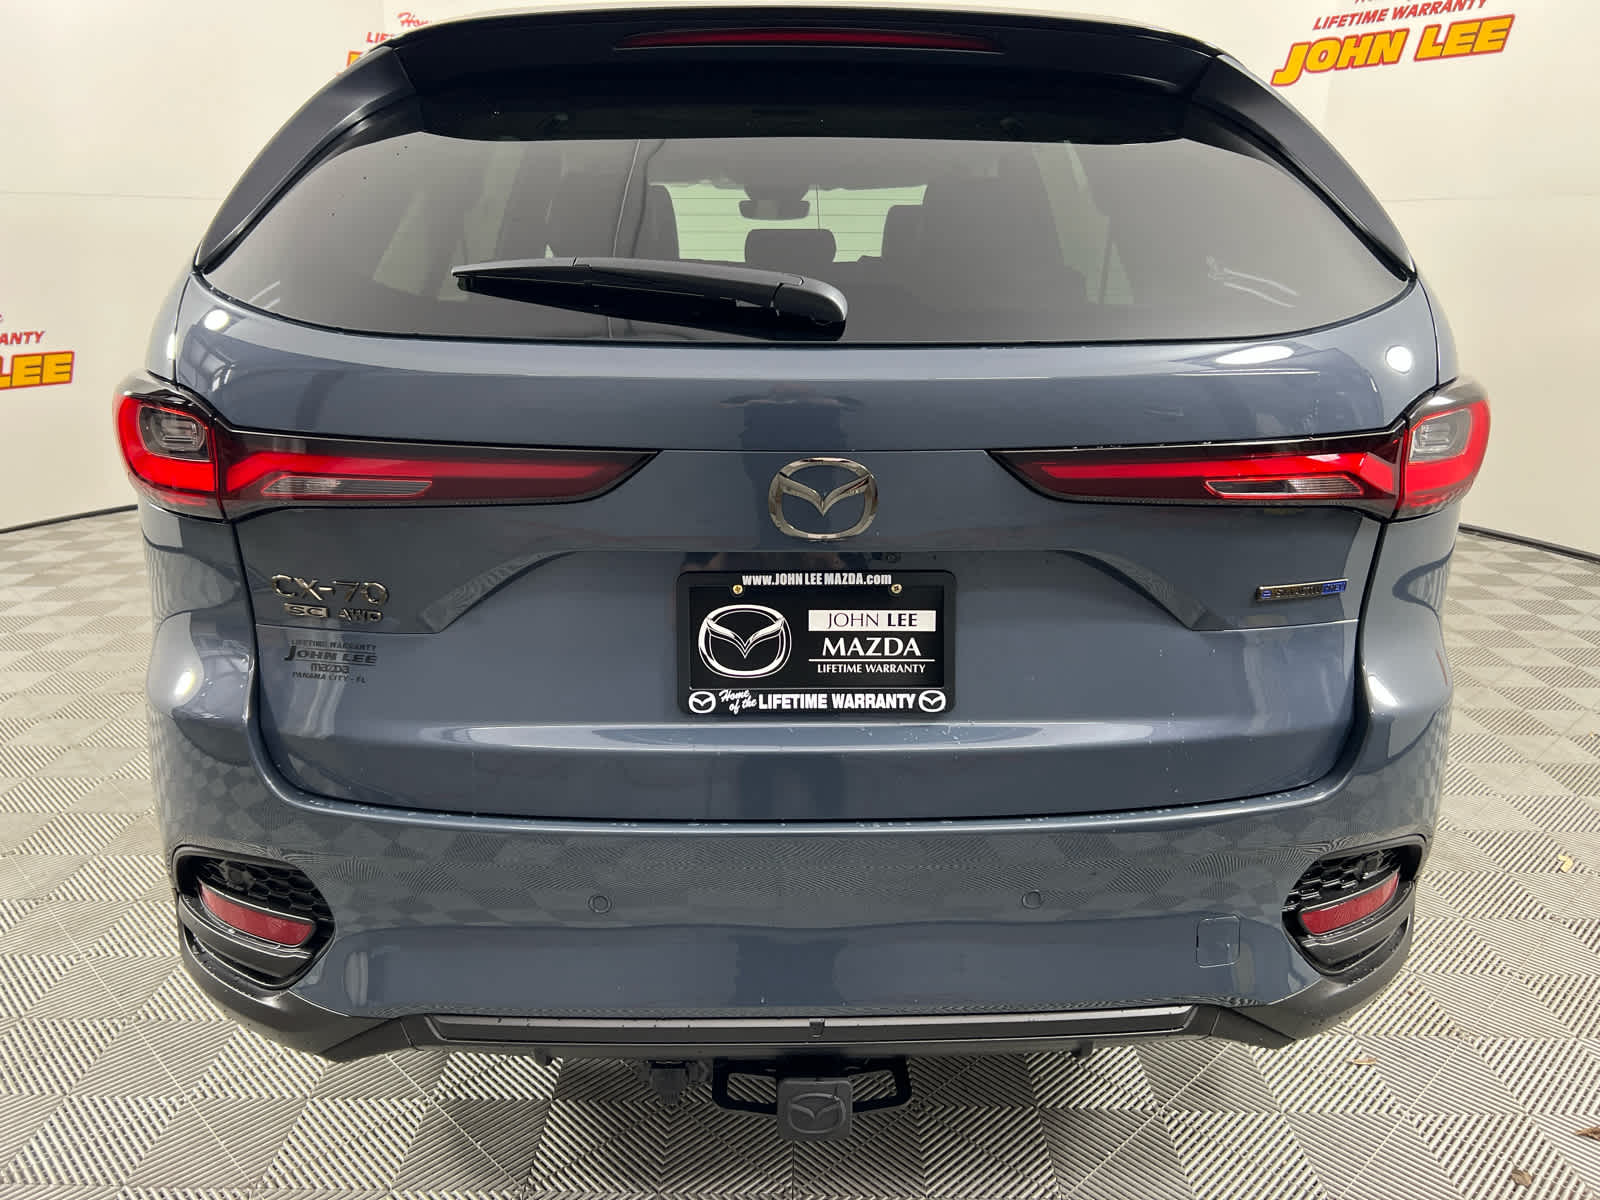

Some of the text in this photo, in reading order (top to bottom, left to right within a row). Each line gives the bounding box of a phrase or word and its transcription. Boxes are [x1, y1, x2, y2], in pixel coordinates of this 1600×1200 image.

[1312, 0, 1488, 31] LIFETIME WARRANTY
[1270, 14, 1515, 87] JOHN LEE
[0, 331, 46, 345] ANTY
[271, 574, 389, 605] CX-70
[339, 608, 383, 622] AWD
[828, 612, 918, 629] JOHN LEE
[284, 646, 378, 664] JOHN LEE
[822, 637, 922, 656] MAZDA
[817, 663, 926, 673] LIFETIME WARRANTY
[718, 689, 751, 703] Home
[758, 693, 916, 709] LIFETIME WARRANTY
[728, 695, 757, 715] of the
